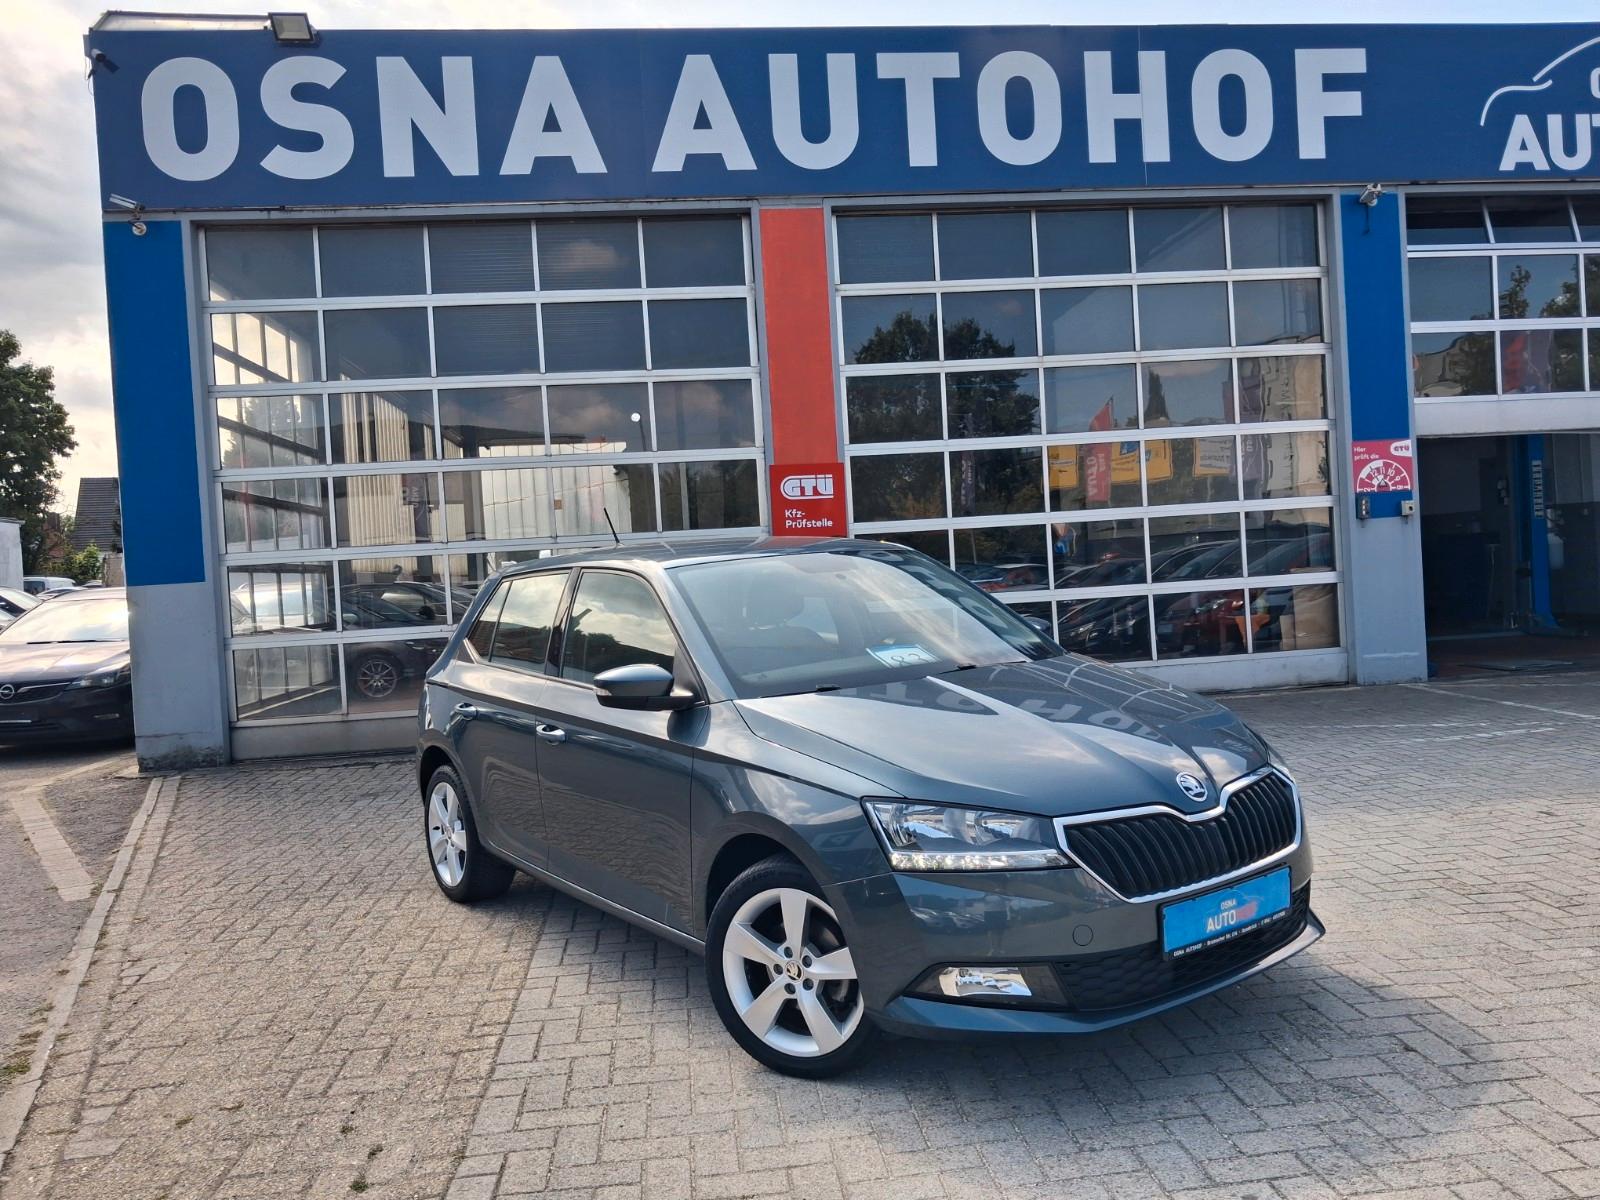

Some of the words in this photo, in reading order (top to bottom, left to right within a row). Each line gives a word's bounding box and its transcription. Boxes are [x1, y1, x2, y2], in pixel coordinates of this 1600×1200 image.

[142, 56, 607, 181] OSNA
[652, 49, 1366, 172] AUTOHOF
[1499, 113, 1600, 171] AU
[784, 508, 806, 518] Kfz-
[785, 518, 833, 529] Prüfstelle
[1220, 898, 1237, 910] OSNA
